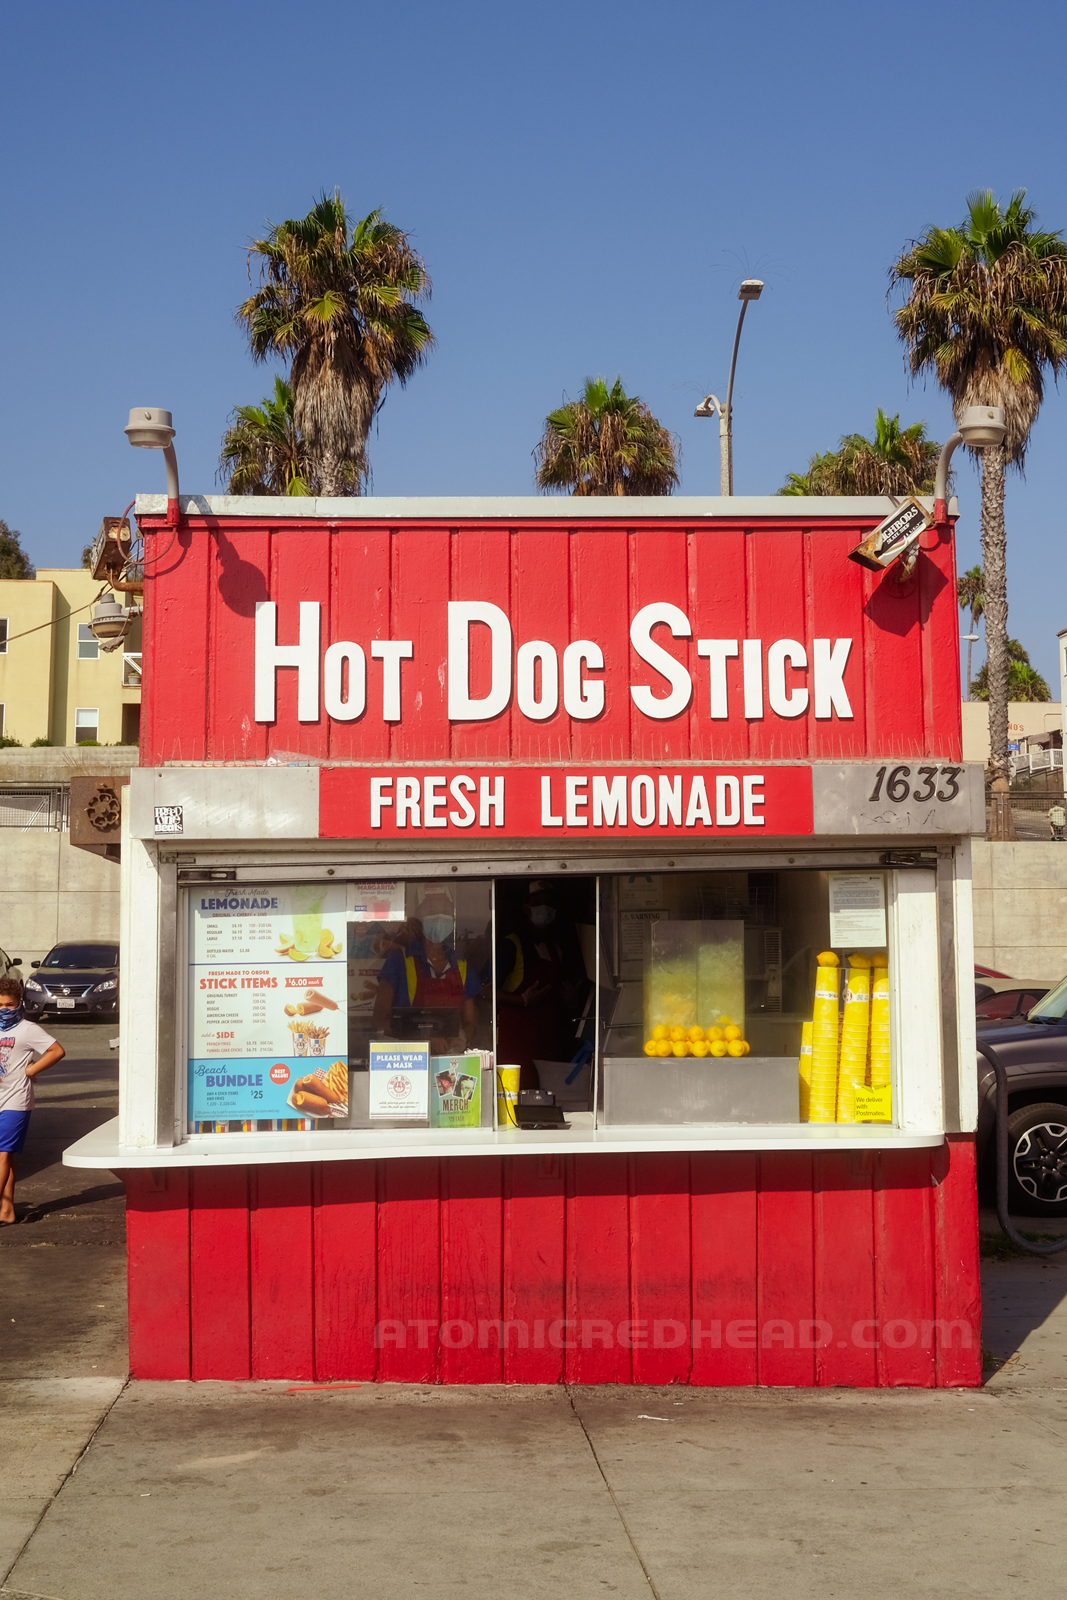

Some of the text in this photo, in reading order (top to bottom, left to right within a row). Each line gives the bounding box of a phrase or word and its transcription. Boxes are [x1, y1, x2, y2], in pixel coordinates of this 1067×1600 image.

[255, 601, 854, 723] HOT DOG STICK
[868, 766, 962, 803] 1633
[370, 774, 765, 828] FRESH LEMONADE
[225, 889, 248, 897] Fresh
[201, 898, 278, 910] LEMONADE
[200, 978, 278, 990] STICK ITEMS
[194, 1065, 228, 1076] Beach
[206, 1074, 262, 1087] BUNDLE
[251, 1090, 263, 1099] $25
[443, 1099, 468, 1111] MERCH
